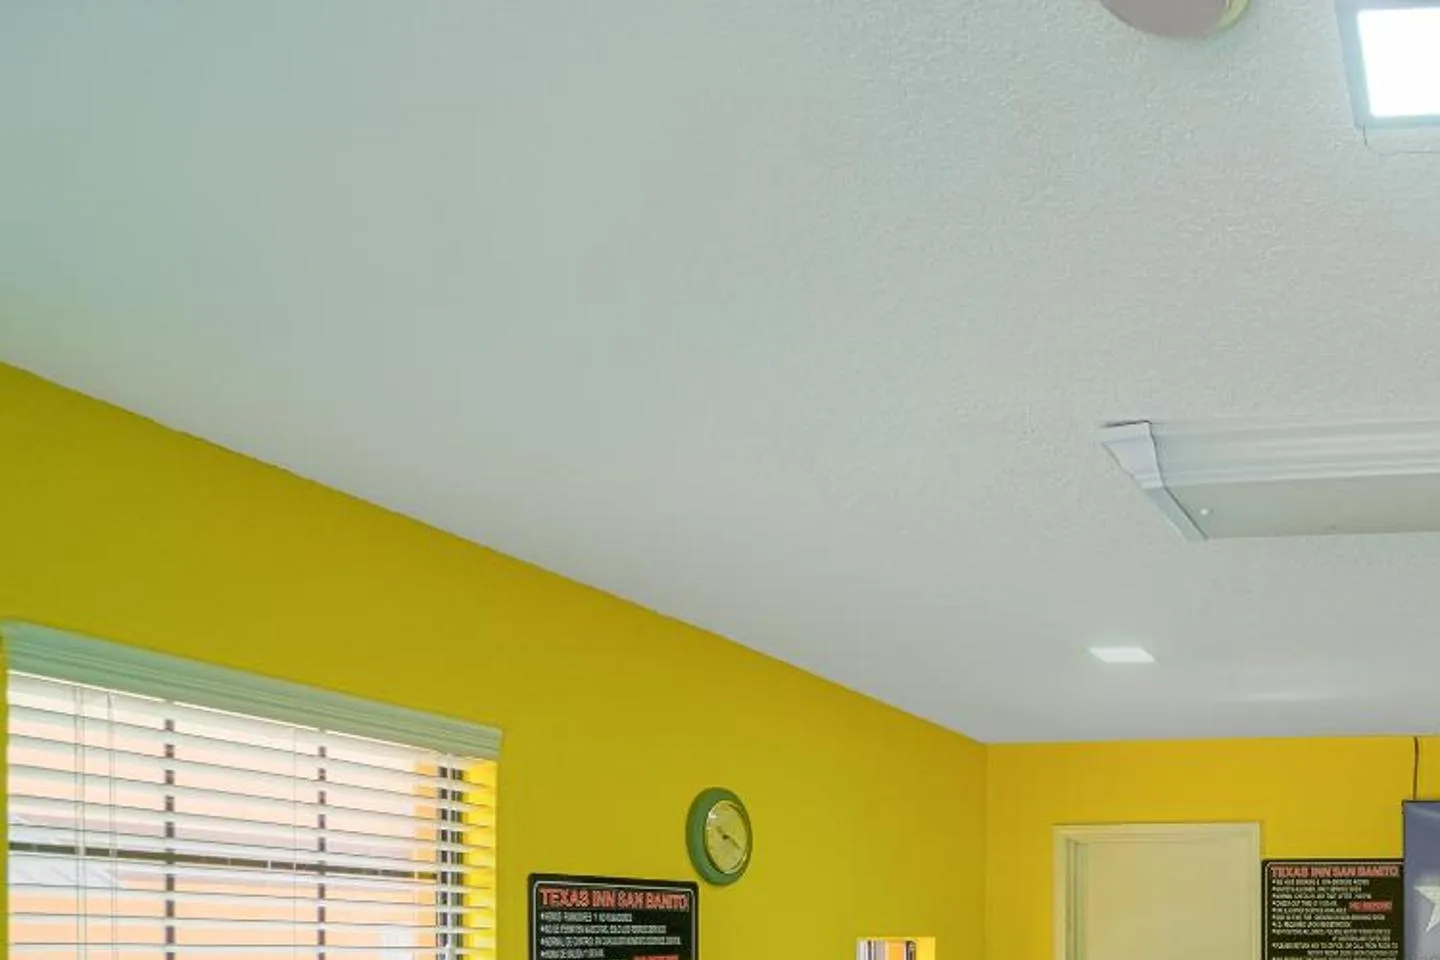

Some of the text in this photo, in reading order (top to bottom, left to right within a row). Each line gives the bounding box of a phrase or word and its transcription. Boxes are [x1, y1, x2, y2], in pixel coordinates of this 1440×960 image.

[1271, 866, 1310, 878] TEXAS
[1311, 866, 1331, 878] INN
[1332, 866, 1355, 878] SAN
[539, 888, 590, 908] TEXAS
[592, 890, 616, 909] INN
[617, 891, 644, 909] SAN
